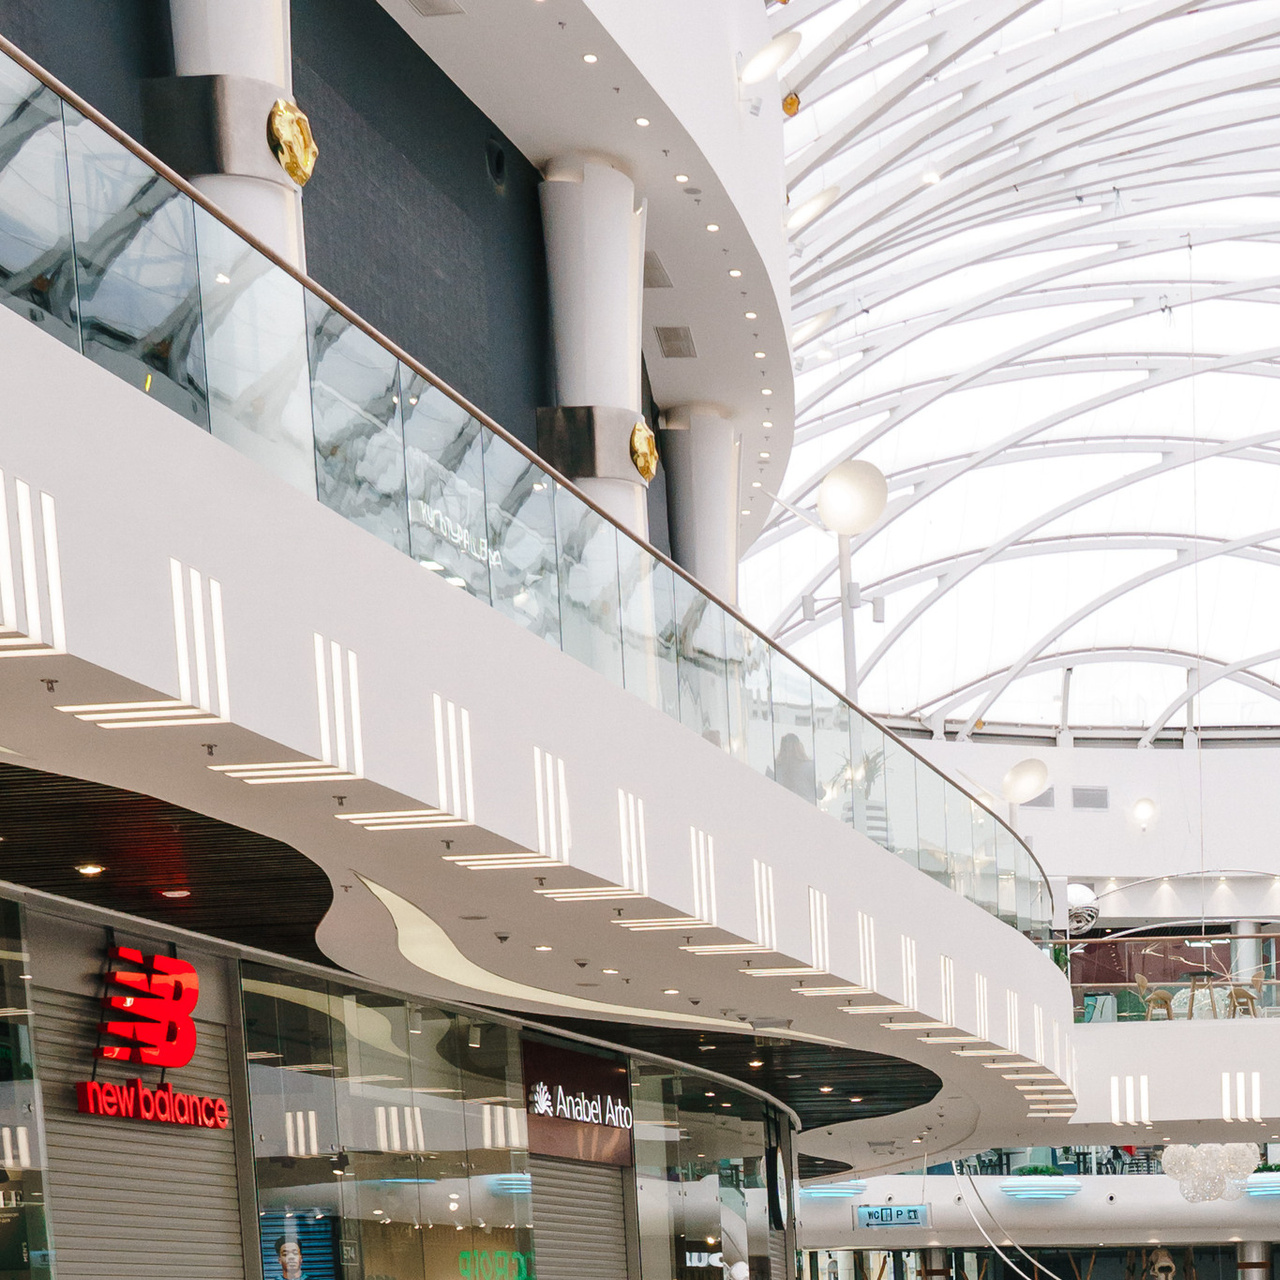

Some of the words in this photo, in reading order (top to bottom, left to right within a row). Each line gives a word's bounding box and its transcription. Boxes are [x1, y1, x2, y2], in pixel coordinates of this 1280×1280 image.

[78, 1080, 134, 1118] new
[134, 1078, 229, 1130] balance
[556, 1085, 602, 1124] Anabel
[605, 1095, 633, 1129] Arto
[867, 1210, 880, 1219] WC
[896, 1210, 903, 1219] P
